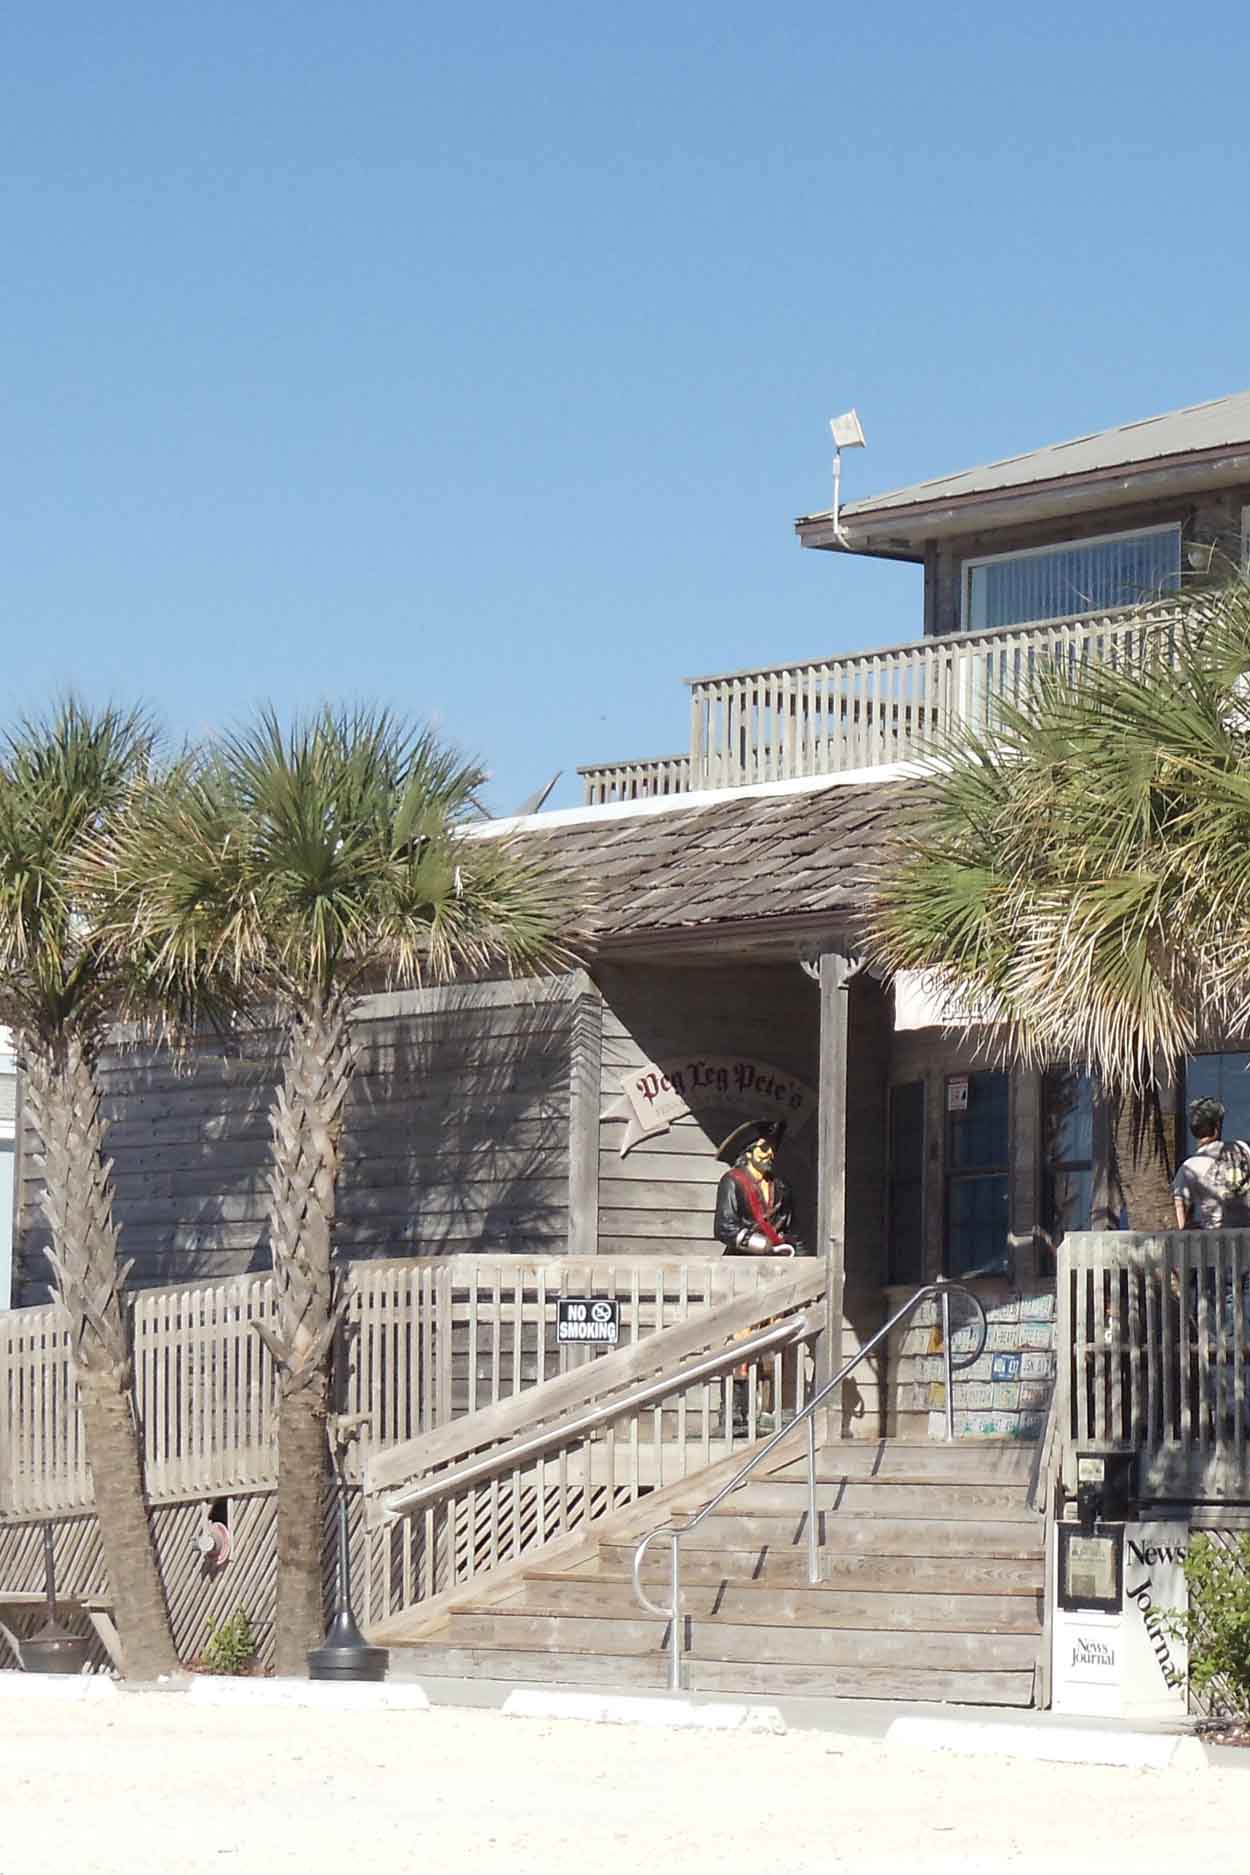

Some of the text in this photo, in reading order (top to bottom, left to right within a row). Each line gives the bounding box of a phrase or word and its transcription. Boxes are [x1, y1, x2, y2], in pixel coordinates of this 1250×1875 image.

[636, 1070, 687, 1105] Peg
[687, 1060, 729, 1092] Leg
[568, 1304, 587, 1321] NO
[560, 1322, 616, 1339] SMOKING
[1127, 1539, 1186, 1566] News
[1077, 1637, 1108, 1653] News
[1072, 1648, 1115, 1667] Journal
